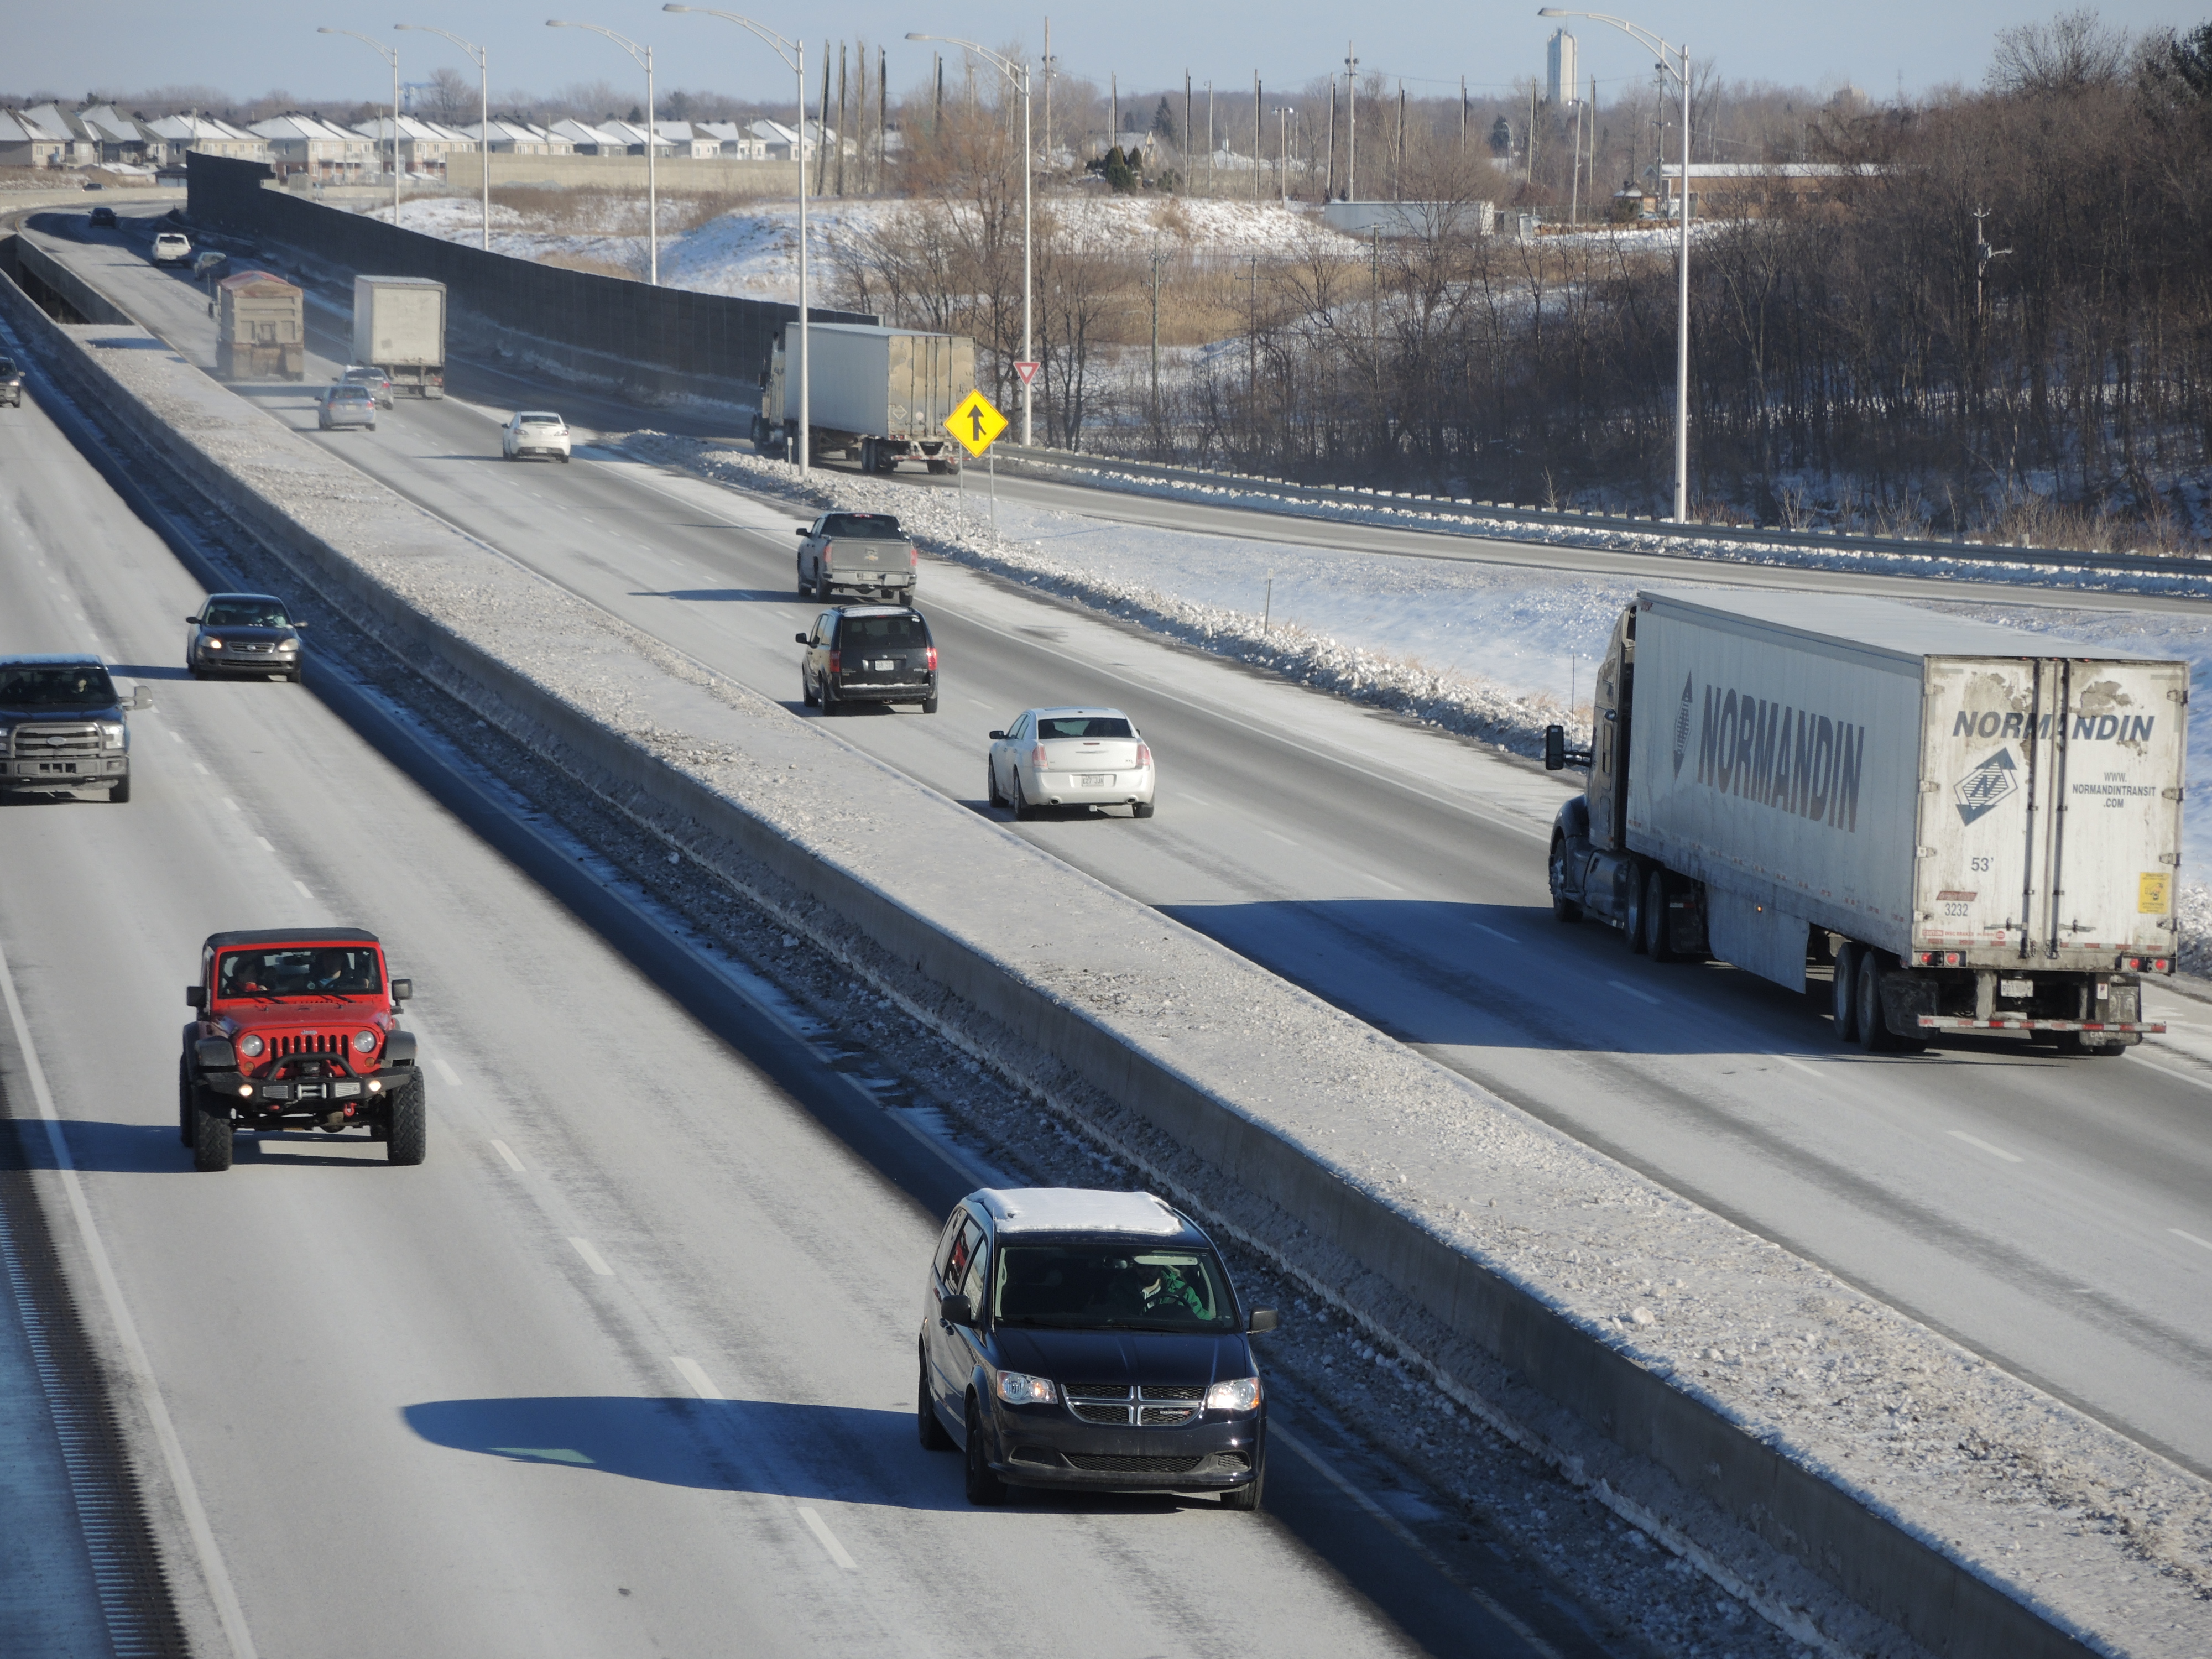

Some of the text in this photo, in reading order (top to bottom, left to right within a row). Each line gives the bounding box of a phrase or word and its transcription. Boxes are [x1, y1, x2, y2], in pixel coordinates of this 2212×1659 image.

[1952, 711, 2155, 742] NORMANDIN
[1697, 684, 1865, 833] NORMANDIN
[2104, 772, 2127, 782] WWW.
[2073, 784, 2156, 796] NORMANDINTRANSIT
[2104, 798, 2124, 808] .COM
[1971, 857, 1994, 872] 53'
[1945, 903, 1968, 916] 3232
